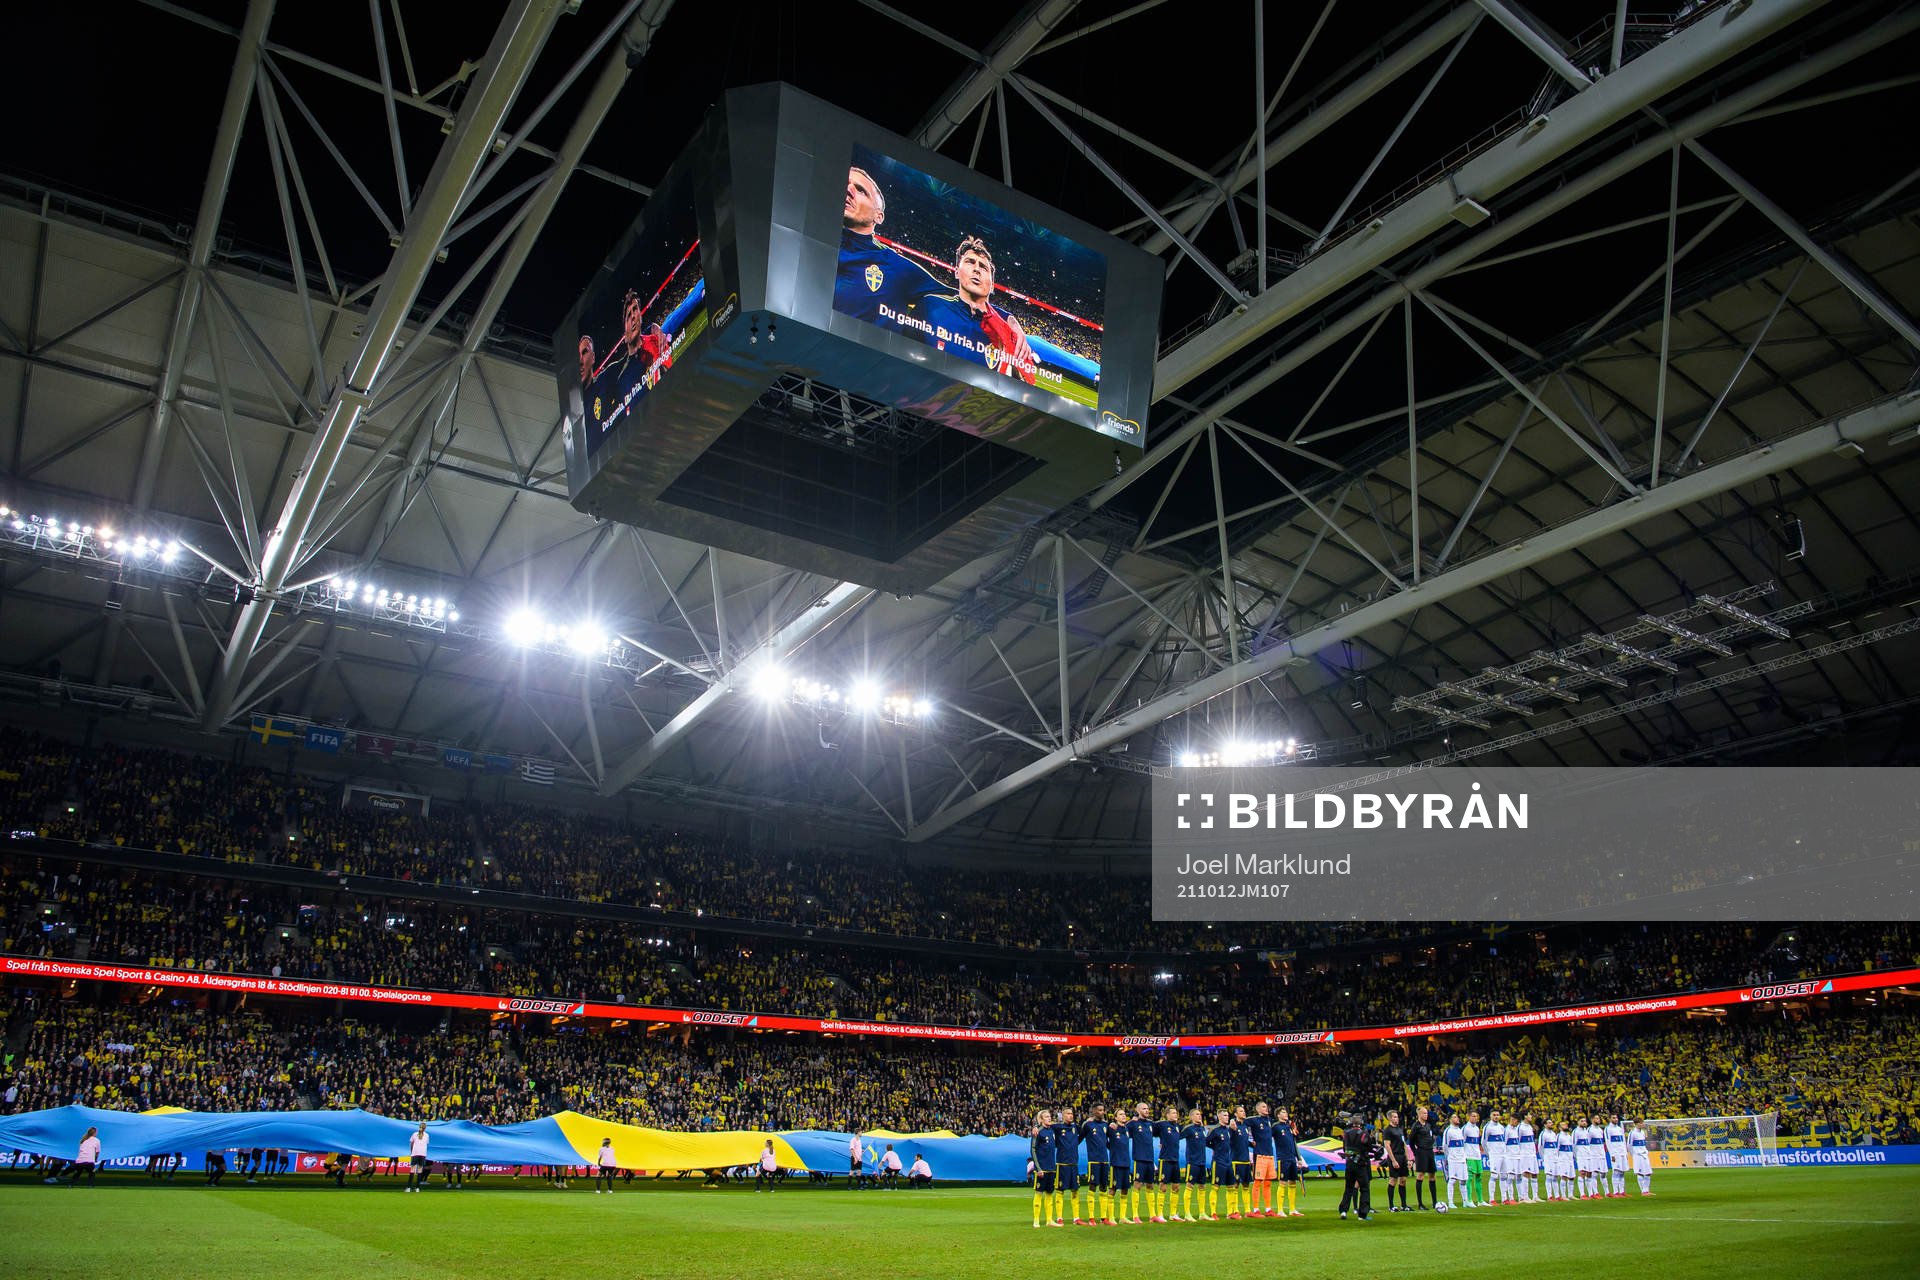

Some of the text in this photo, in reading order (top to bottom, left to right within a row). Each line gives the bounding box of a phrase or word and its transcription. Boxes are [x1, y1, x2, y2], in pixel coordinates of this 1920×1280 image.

[879, 303, 896, 320] Du
[897, 313, 935, 336] gamla,
[936, 325, 952, 342] Du
[953, 333, 975, 351] fria,
[976, 341, 992, 358] Du
[1039, 367, 1063, 383] nord
[1107, 417, 1134, 434] friends
[311, 733, 338, 747] FIFA
[446, 754, 469, 767] UEFA
[373, 799, 399, 809] friends
[6, 960, 432, 1002] Spel från Svenska Spel Sport & Casino AB. Åldersgräns 18 år. Stödlinjen 020-81 91 00. Spelalagom.se
[1751, 980, 1820, 1000] ODDSET
[509, 998, 574, 1013] ODDSET
[692, 1011, 748, 1025] ODDSET
[1417, 1024, 1439, 1032] Svenska
[1440, 1023, 1452, 1031] Spel
[1452, 1021, 1468, 1030] Sport
[1474, 1019, 1493, 1027] Casino
[1555, 1008, 1586, 1018] Stödlinjen
[1587, 1006, 1607, 1015] 020-81
[1626, 999, 1677, 1011] Spelalagom.se
[820, 1021, 834, 1030] Spel
[847, 1023, 870, 1031] Svenska
[870, 1024, 884, 1033] Spel
[884, 1025, 900, 1034] Sport
[1122, 1036, 1170, 1046] ODDSET
[1274, 1031, 1325, 1044] ODDSET
[1705, 1149, 1886, 1165] #tillsammansförfotbollen
